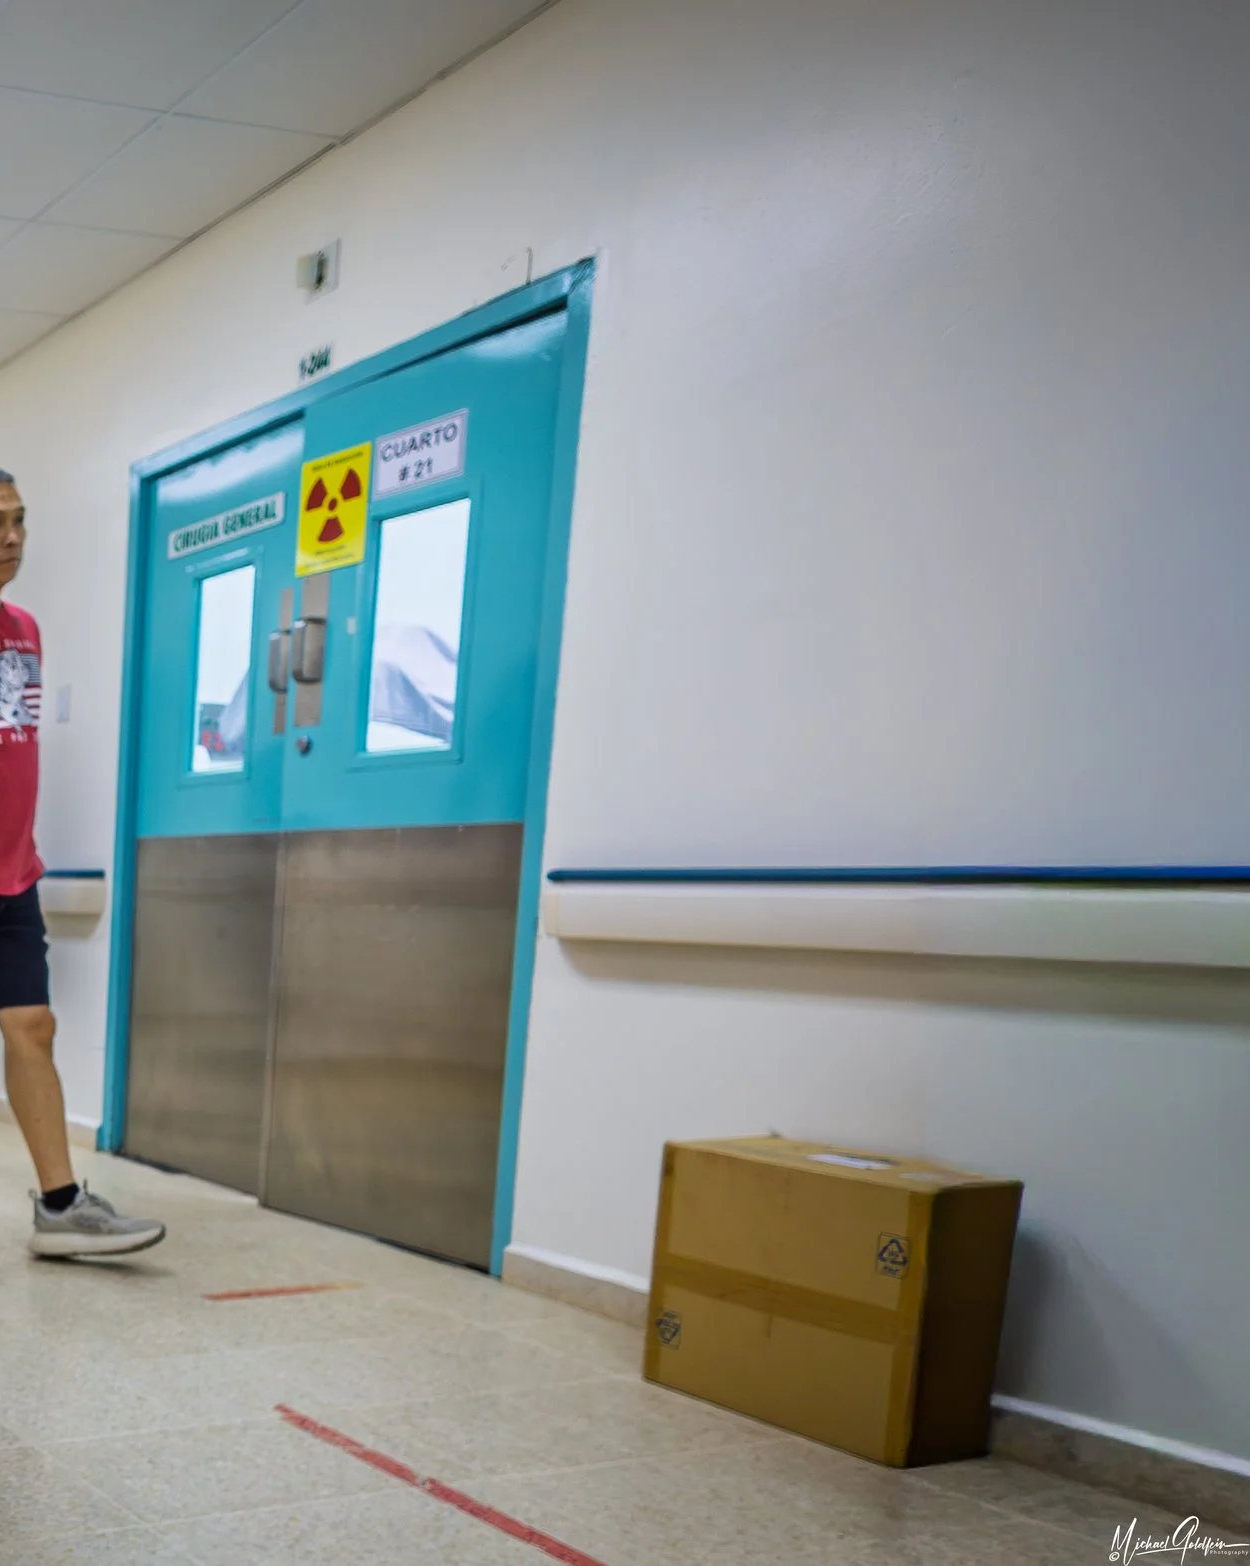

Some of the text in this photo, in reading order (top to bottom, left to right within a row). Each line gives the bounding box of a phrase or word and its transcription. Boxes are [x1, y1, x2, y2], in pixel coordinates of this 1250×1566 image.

[380, 422, 458, 462] CUARTO
[398, 457, 433, 482] # 21
[223, 501, 276, 535] GENERAL
